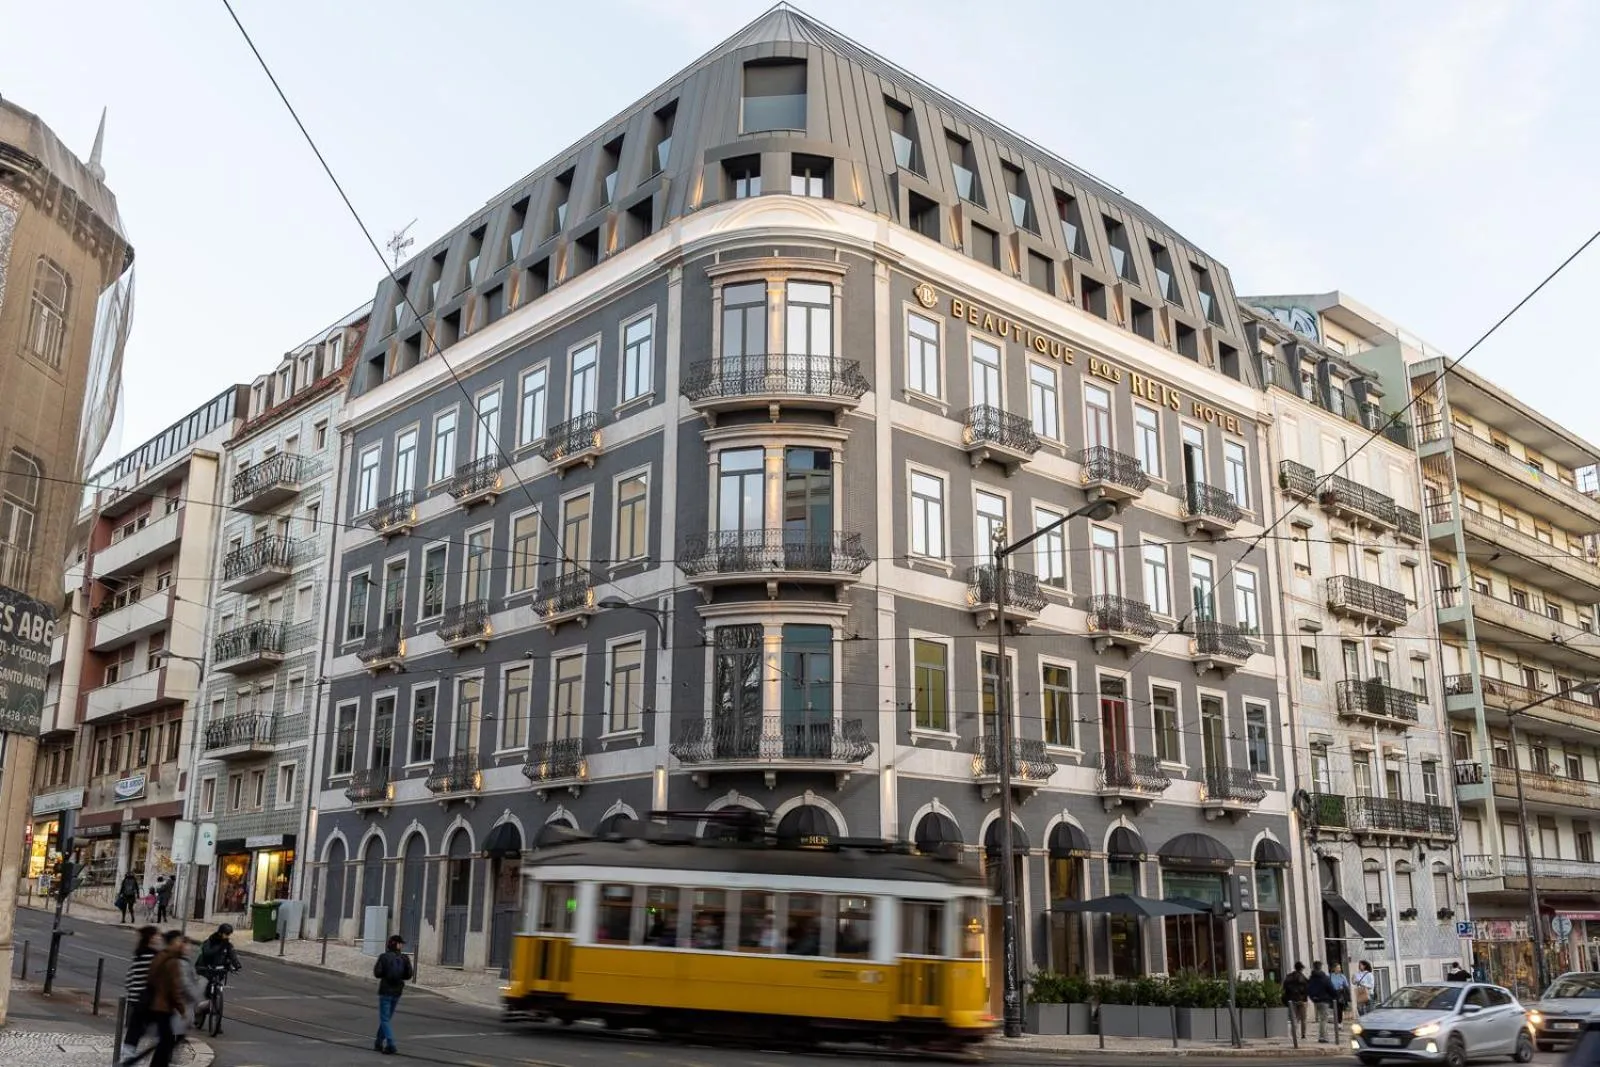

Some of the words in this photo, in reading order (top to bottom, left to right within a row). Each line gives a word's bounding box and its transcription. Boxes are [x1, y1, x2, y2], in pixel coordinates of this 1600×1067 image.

[952, 299, 1074, 365] BEAUTIQUE
[1090, 358, 1120, 382] DOS
[1130, 372, 1181, 411] REIS
[1192, 402, 1244, 436] HOTEL
